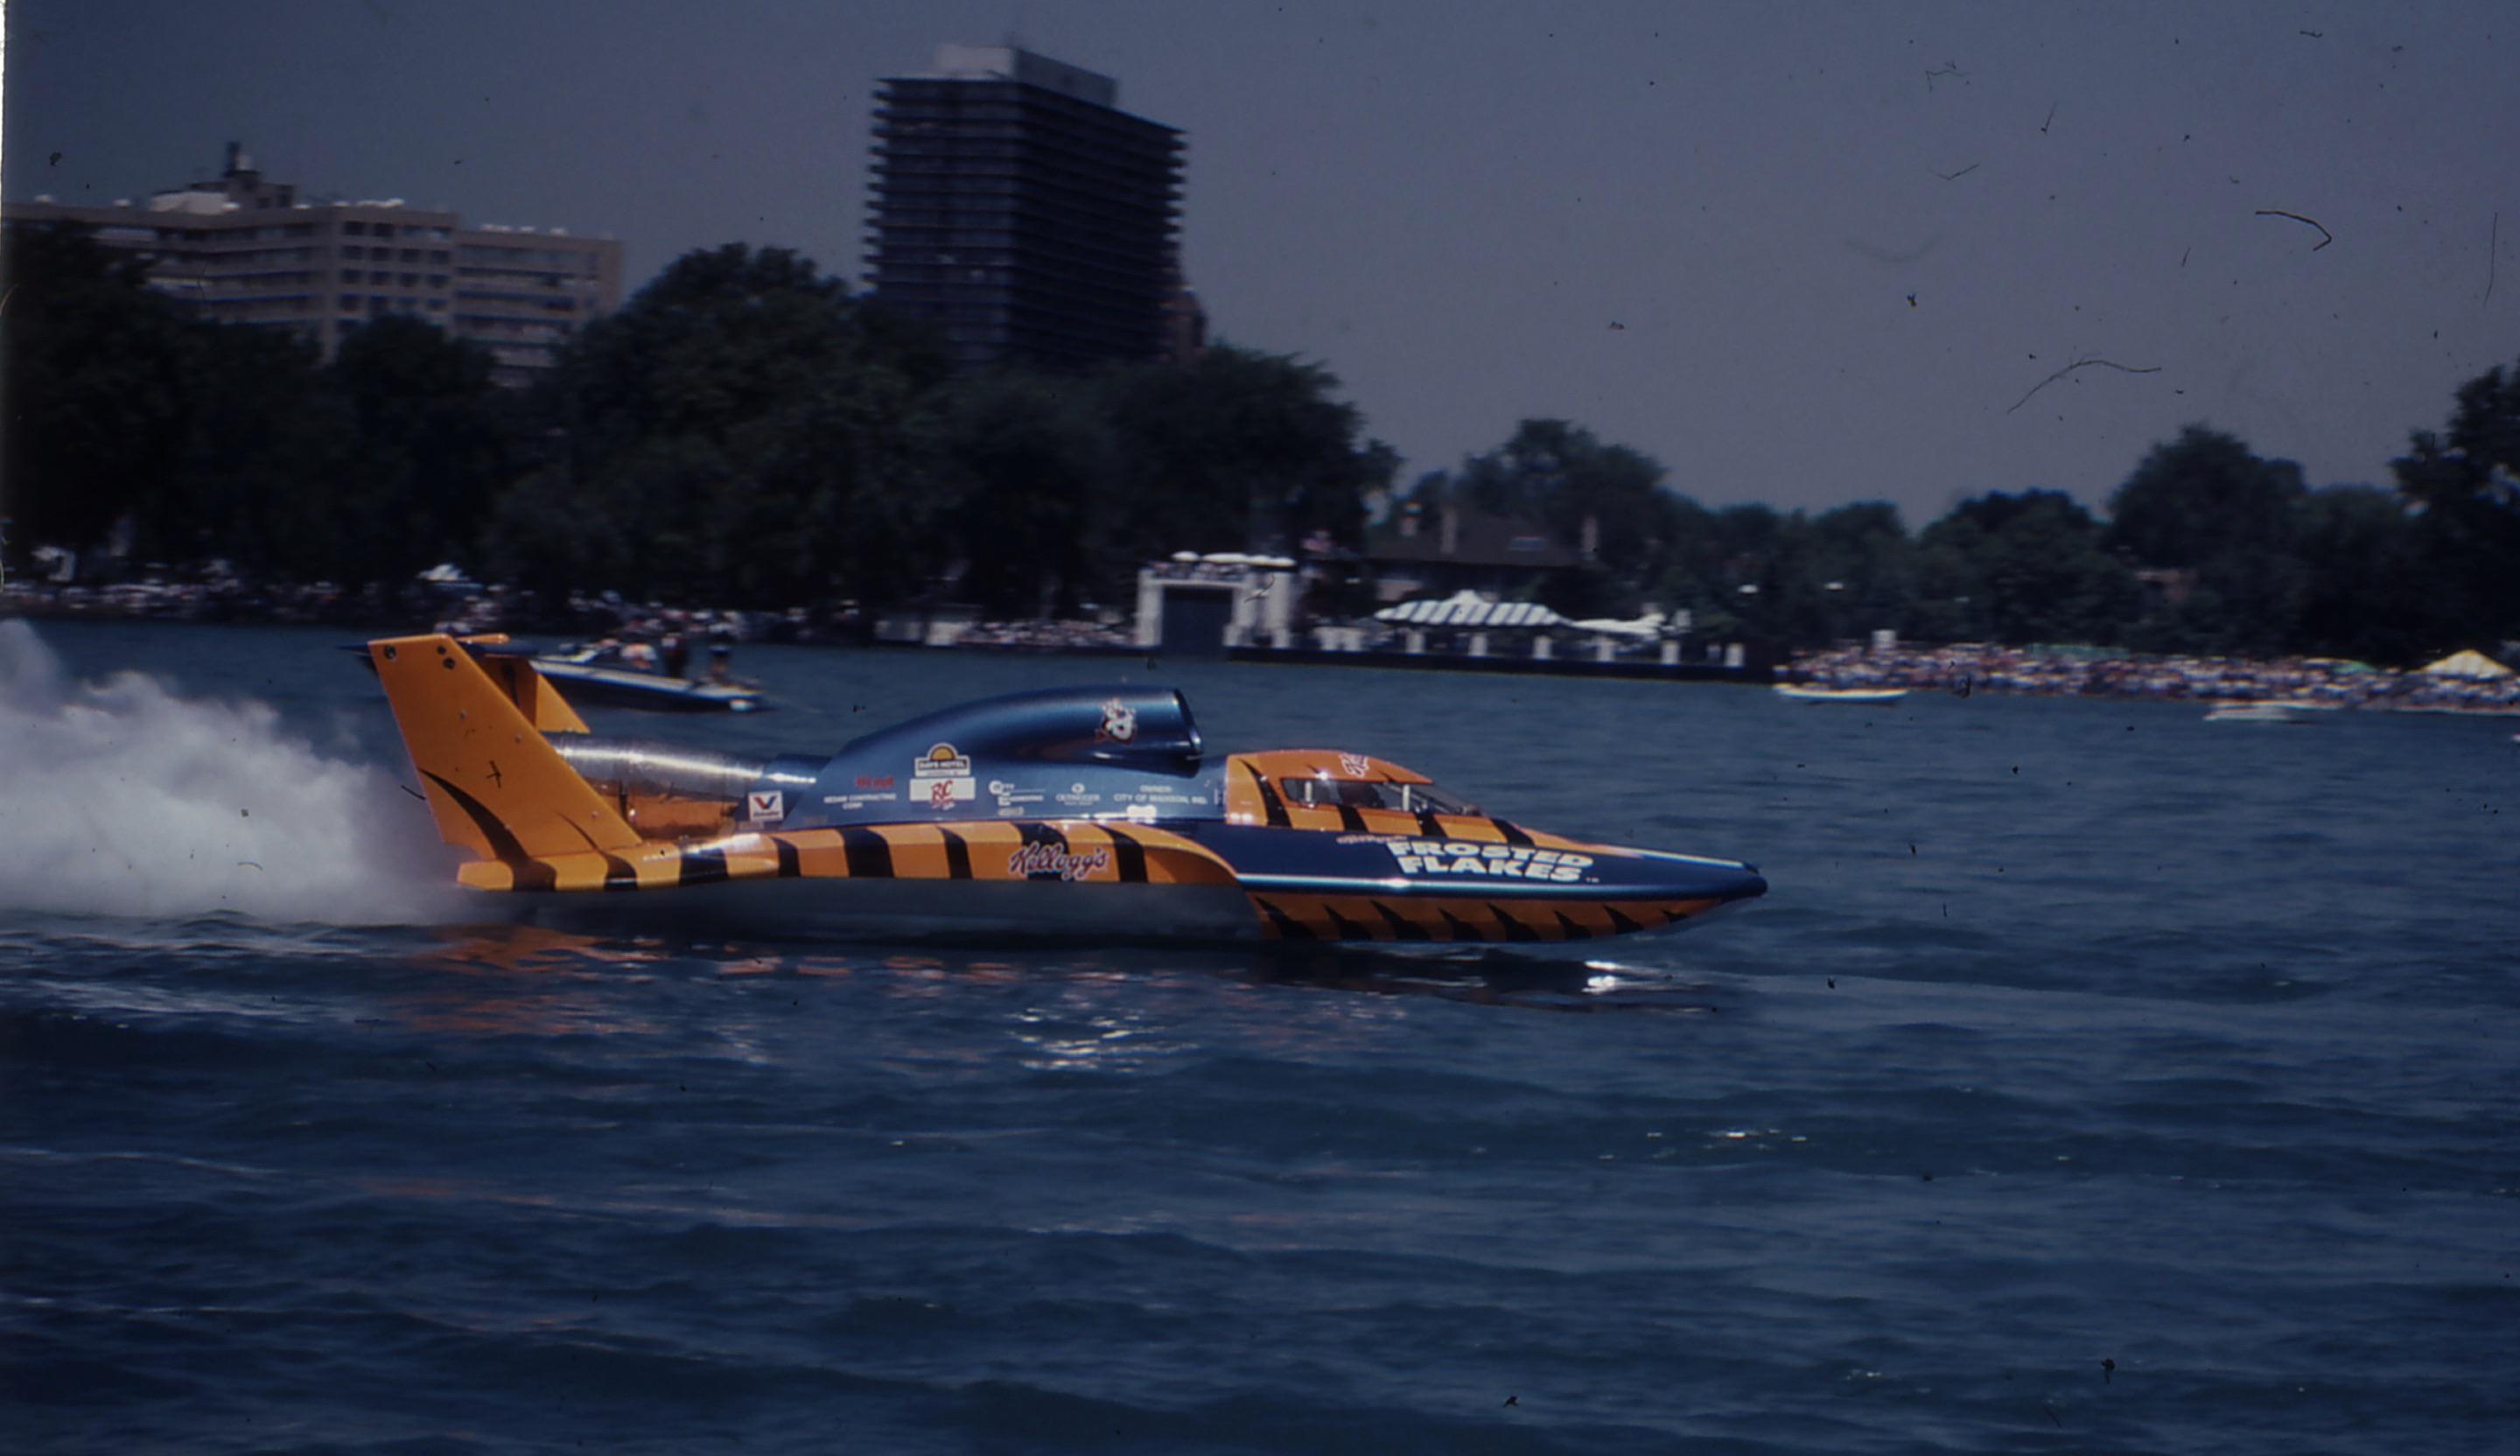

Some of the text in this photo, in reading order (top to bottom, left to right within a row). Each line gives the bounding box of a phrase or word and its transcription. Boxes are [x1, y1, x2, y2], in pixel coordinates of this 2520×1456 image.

[1113, 793, 1133, 802] CITY
[1135, 794, 1147, 802] OF
[1009, 841, 1109, 881] Kellogg's
[1386, 841, 1593, 867] FROSTED
[1397, 855, 1582, 883] FLAKES
